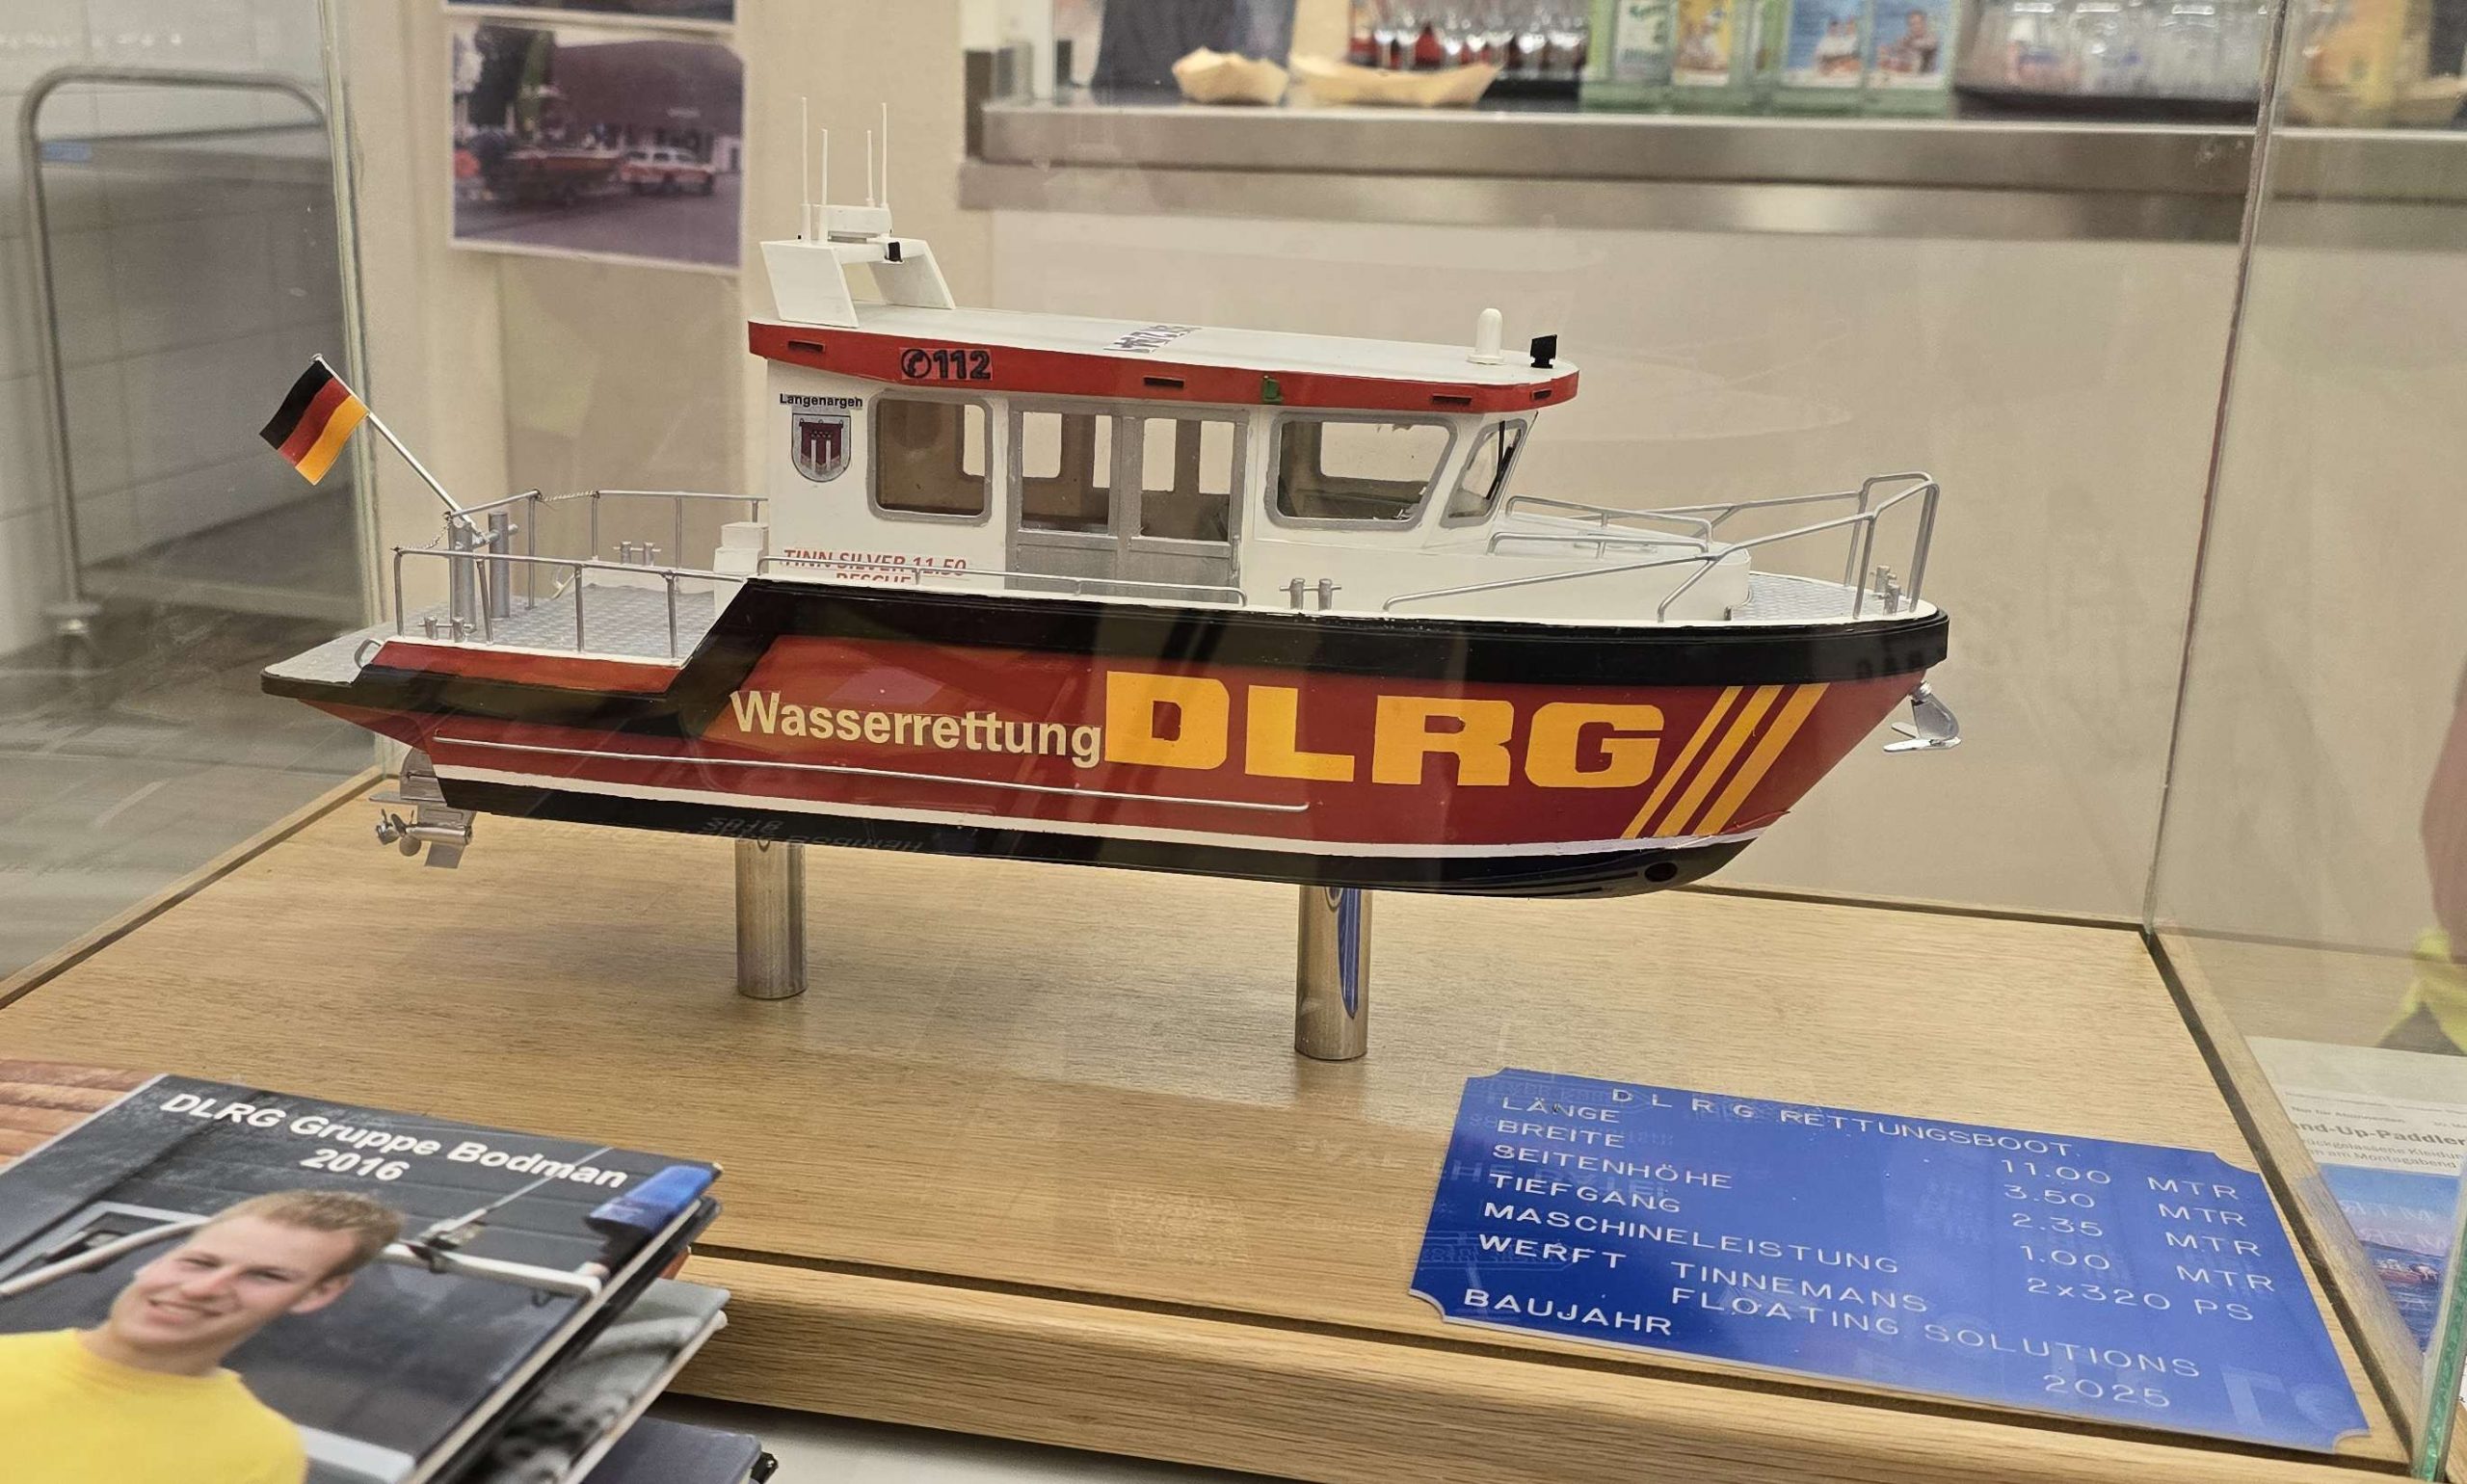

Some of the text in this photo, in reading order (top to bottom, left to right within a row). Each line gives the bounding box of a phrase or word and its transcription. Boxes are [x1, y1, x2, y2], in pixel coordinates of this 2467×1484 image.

[932, 350, 992, 380] 112
[784, 549, 833, 568] TINN
[836, 552, 906, 572] SILVER
[729, 671, 1665, 788] Wasserrettung DLRG
[160, 1092, 629, 1190] DLRG Gruppe Bodman
[300, 1147, 411, 1182] 2016
[1497, 1119, 2248, 1228] BREITE 3.50 MTR
[1501, 1097, 2240, 1202] LÄNGE 11.00 MTR
[1489, 1173, 1682, 1214] TIEFGANG
[2019, 1245, 2111, 1271] 1.00
[2175, 1264, 2275, 1292] MTR
[1493, 1144, 1734, 1190] SEITENHÖHE
[2011, 1213, 2104, 1238] 2.35
[2165, 1232, 2262, 1258] MTR
[1478, 1232, 1628, 1269] WERFT
[1670, 1260, 1929, 1313] TINNEMANS
[1483, 1202, 1900, 1275] MASCHINELEISTUNG
[2027, 1277, 2171, 1312] 2x320
[2193, 1298, 2254, 1322] PS
[1463, 1288, 2171, 1410] BAUJAHR 2025
[1671, 1287, 2200, 1379] FLOATING SOLUTIONS
